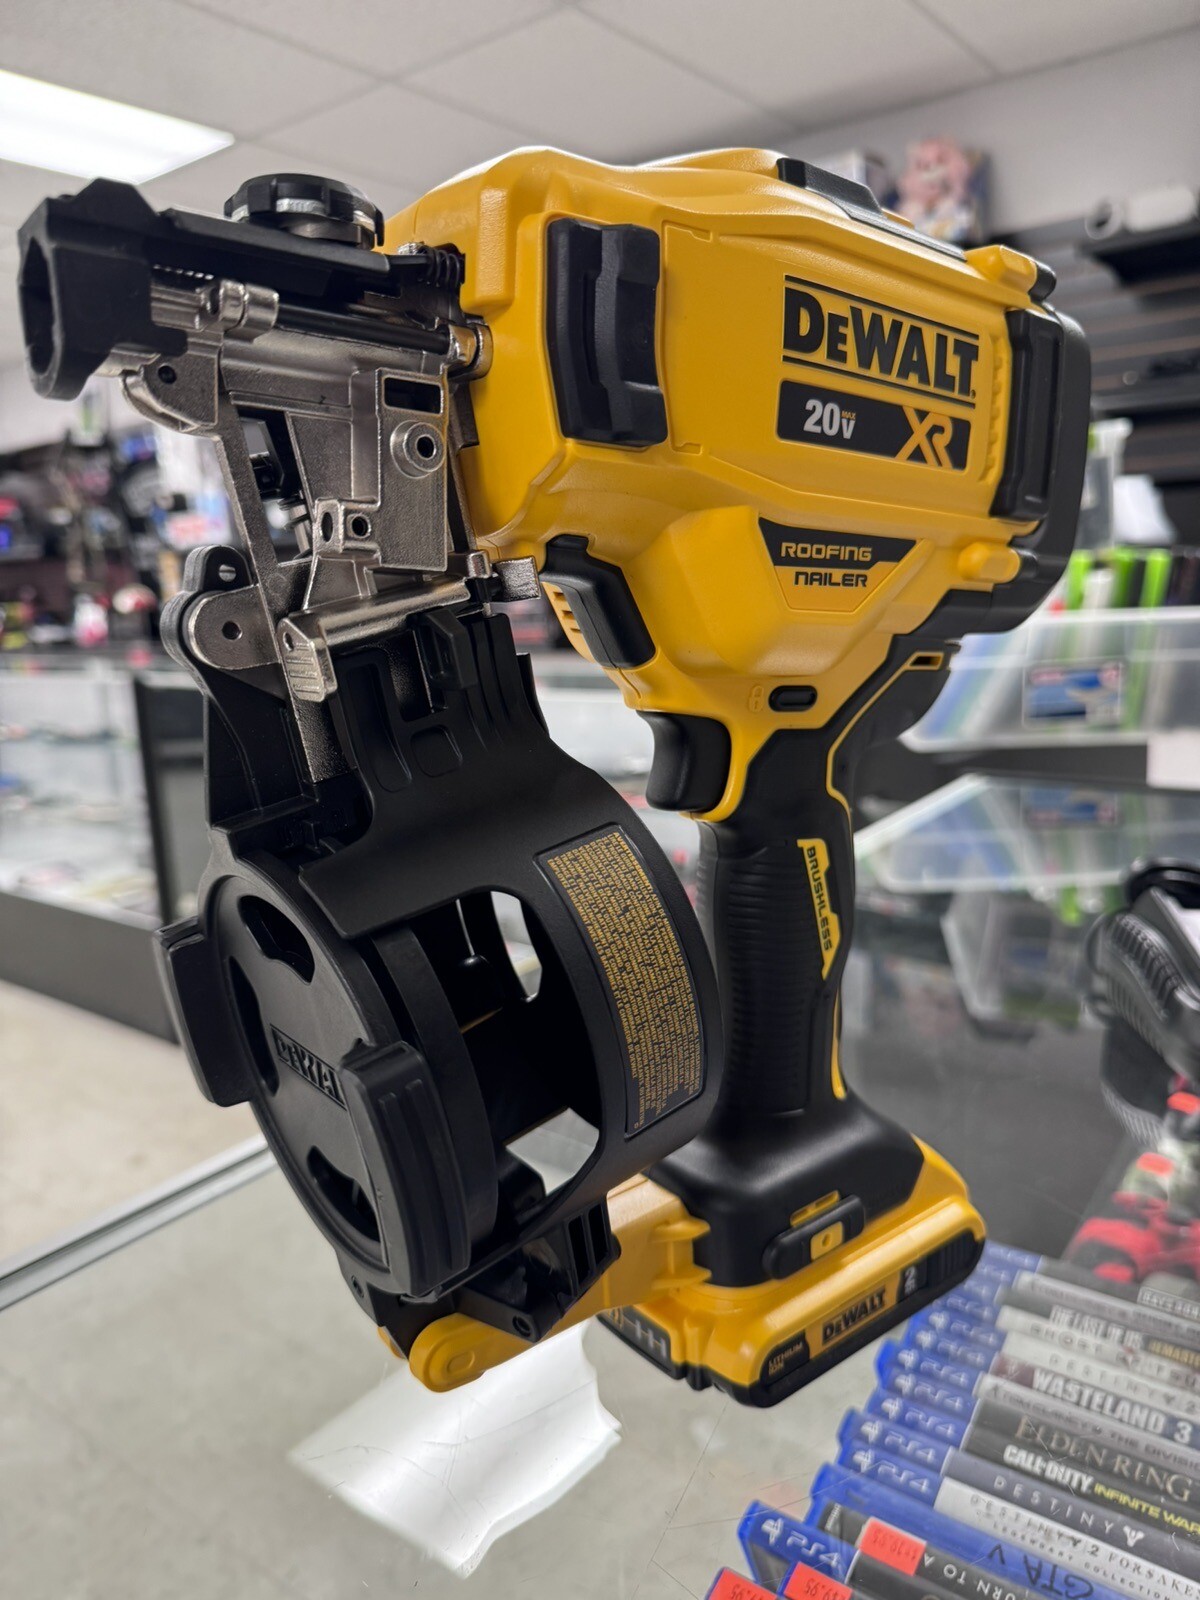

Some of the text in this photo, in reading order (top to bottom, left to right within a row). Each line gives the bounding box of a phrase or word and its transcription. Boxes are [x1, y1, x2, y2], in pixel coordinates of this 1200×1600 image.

[783, 286, 978, 399] DEWALT
[894, 405, 953, 472] XR
[781, 542, 872, 562] ROOFING
[794, 571, 868, 588] NAILER
[806, 846, 833, 952] BRUSHLESS
[1033, 1367, 1193, 1444] WASTELAND 3
[1003, 1444, 1044, 1475] CALL
[1045, 1458, 1094, 1493] DUTY
[1094, 1482, 1161, 1519] INFINITE
[1015, 1415, 1194, 1502] ELDEN RING
[994, 1475, 1114, 1534] DESTINY
[786, 1529, 841, 1569] PS4
[943, 1562, 967, 1580] TO
[986, 1543, 1094, 1600] GTA V
[1088, 1544, 1100, 1557] 2
